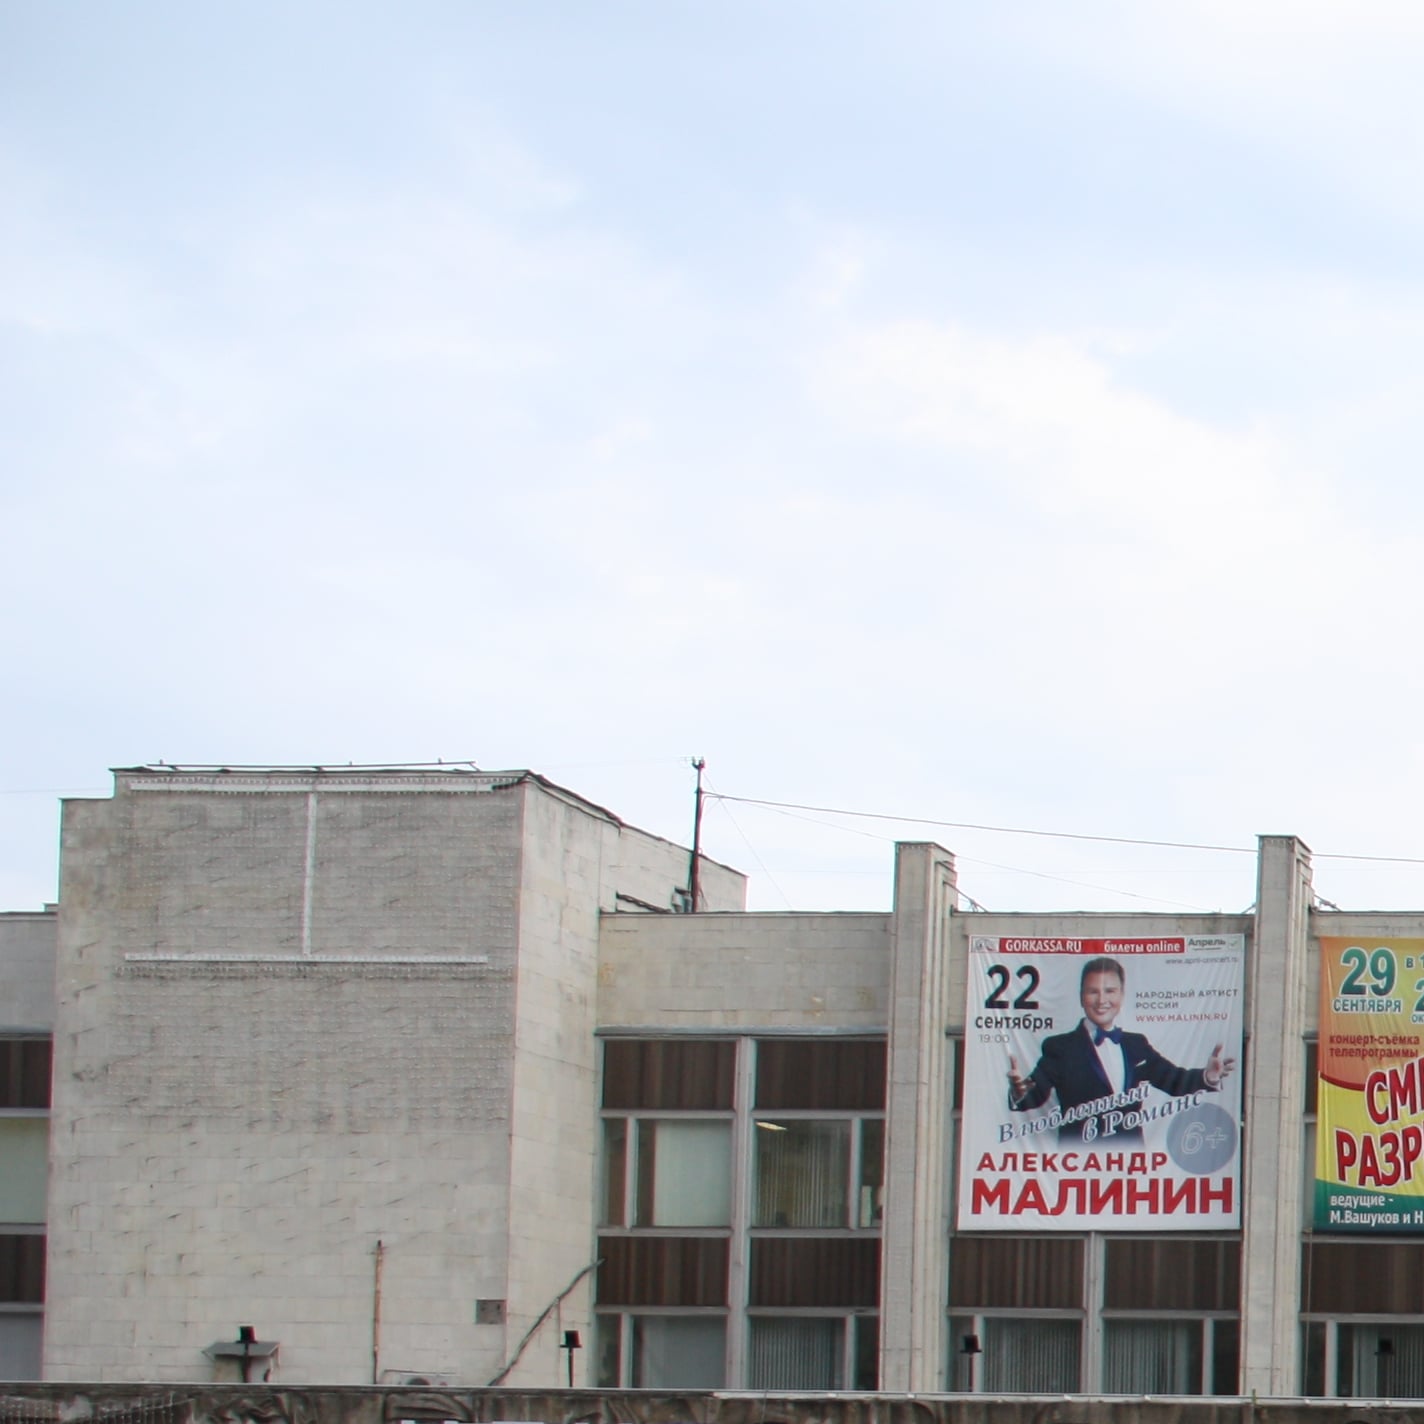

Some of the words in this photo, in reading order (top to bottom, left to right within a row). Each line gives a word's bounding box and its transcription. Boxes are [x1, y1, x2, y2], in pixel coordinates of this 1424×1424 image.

[1005, 940, 1082, 952] GORKASSA.RU
[1104, 941, 1144, 953] билеты
[1146, 940, 1181, 952] online
[1406, 957, 1414, 968] в
[1341, 947, 1397, 997] 29
[985, 964, 1040, 1010] 22
[1136, 989, 1195, 999] НАРОДНЫЙ
[1199, 988, 1238, 998] АРТИСТ
[1136, 1001, 1179, 1009] РОССИИ
[1333, 998, 1401, 1013] СЕНТЯБРЯ
[975, 1014, 1053, 1032] сентября
[1136, 1012, 1228, 1022] WWW.MALININ.RU
[979, 1034, 1009, 1043] 19:00
[1329, 1034, 1420, 1047] концерт-съёмка
[1329, 1047, 1418, 1060] телепрограммы
[998, 1081, 1150, 1143] Влюбленный
[1181, 1122, 1228, 1154] 6+
[976, 1152, 1167, 1175] АЛЕКСАНДР
[971, 1177, 1233, 1216] МАЛИНИН
[1330, 1195, 1385, 1208] ведущие
[1330, 1210, 1399, 1227] М.Вашуков
[1402, 1213, 1410, 1224] и
